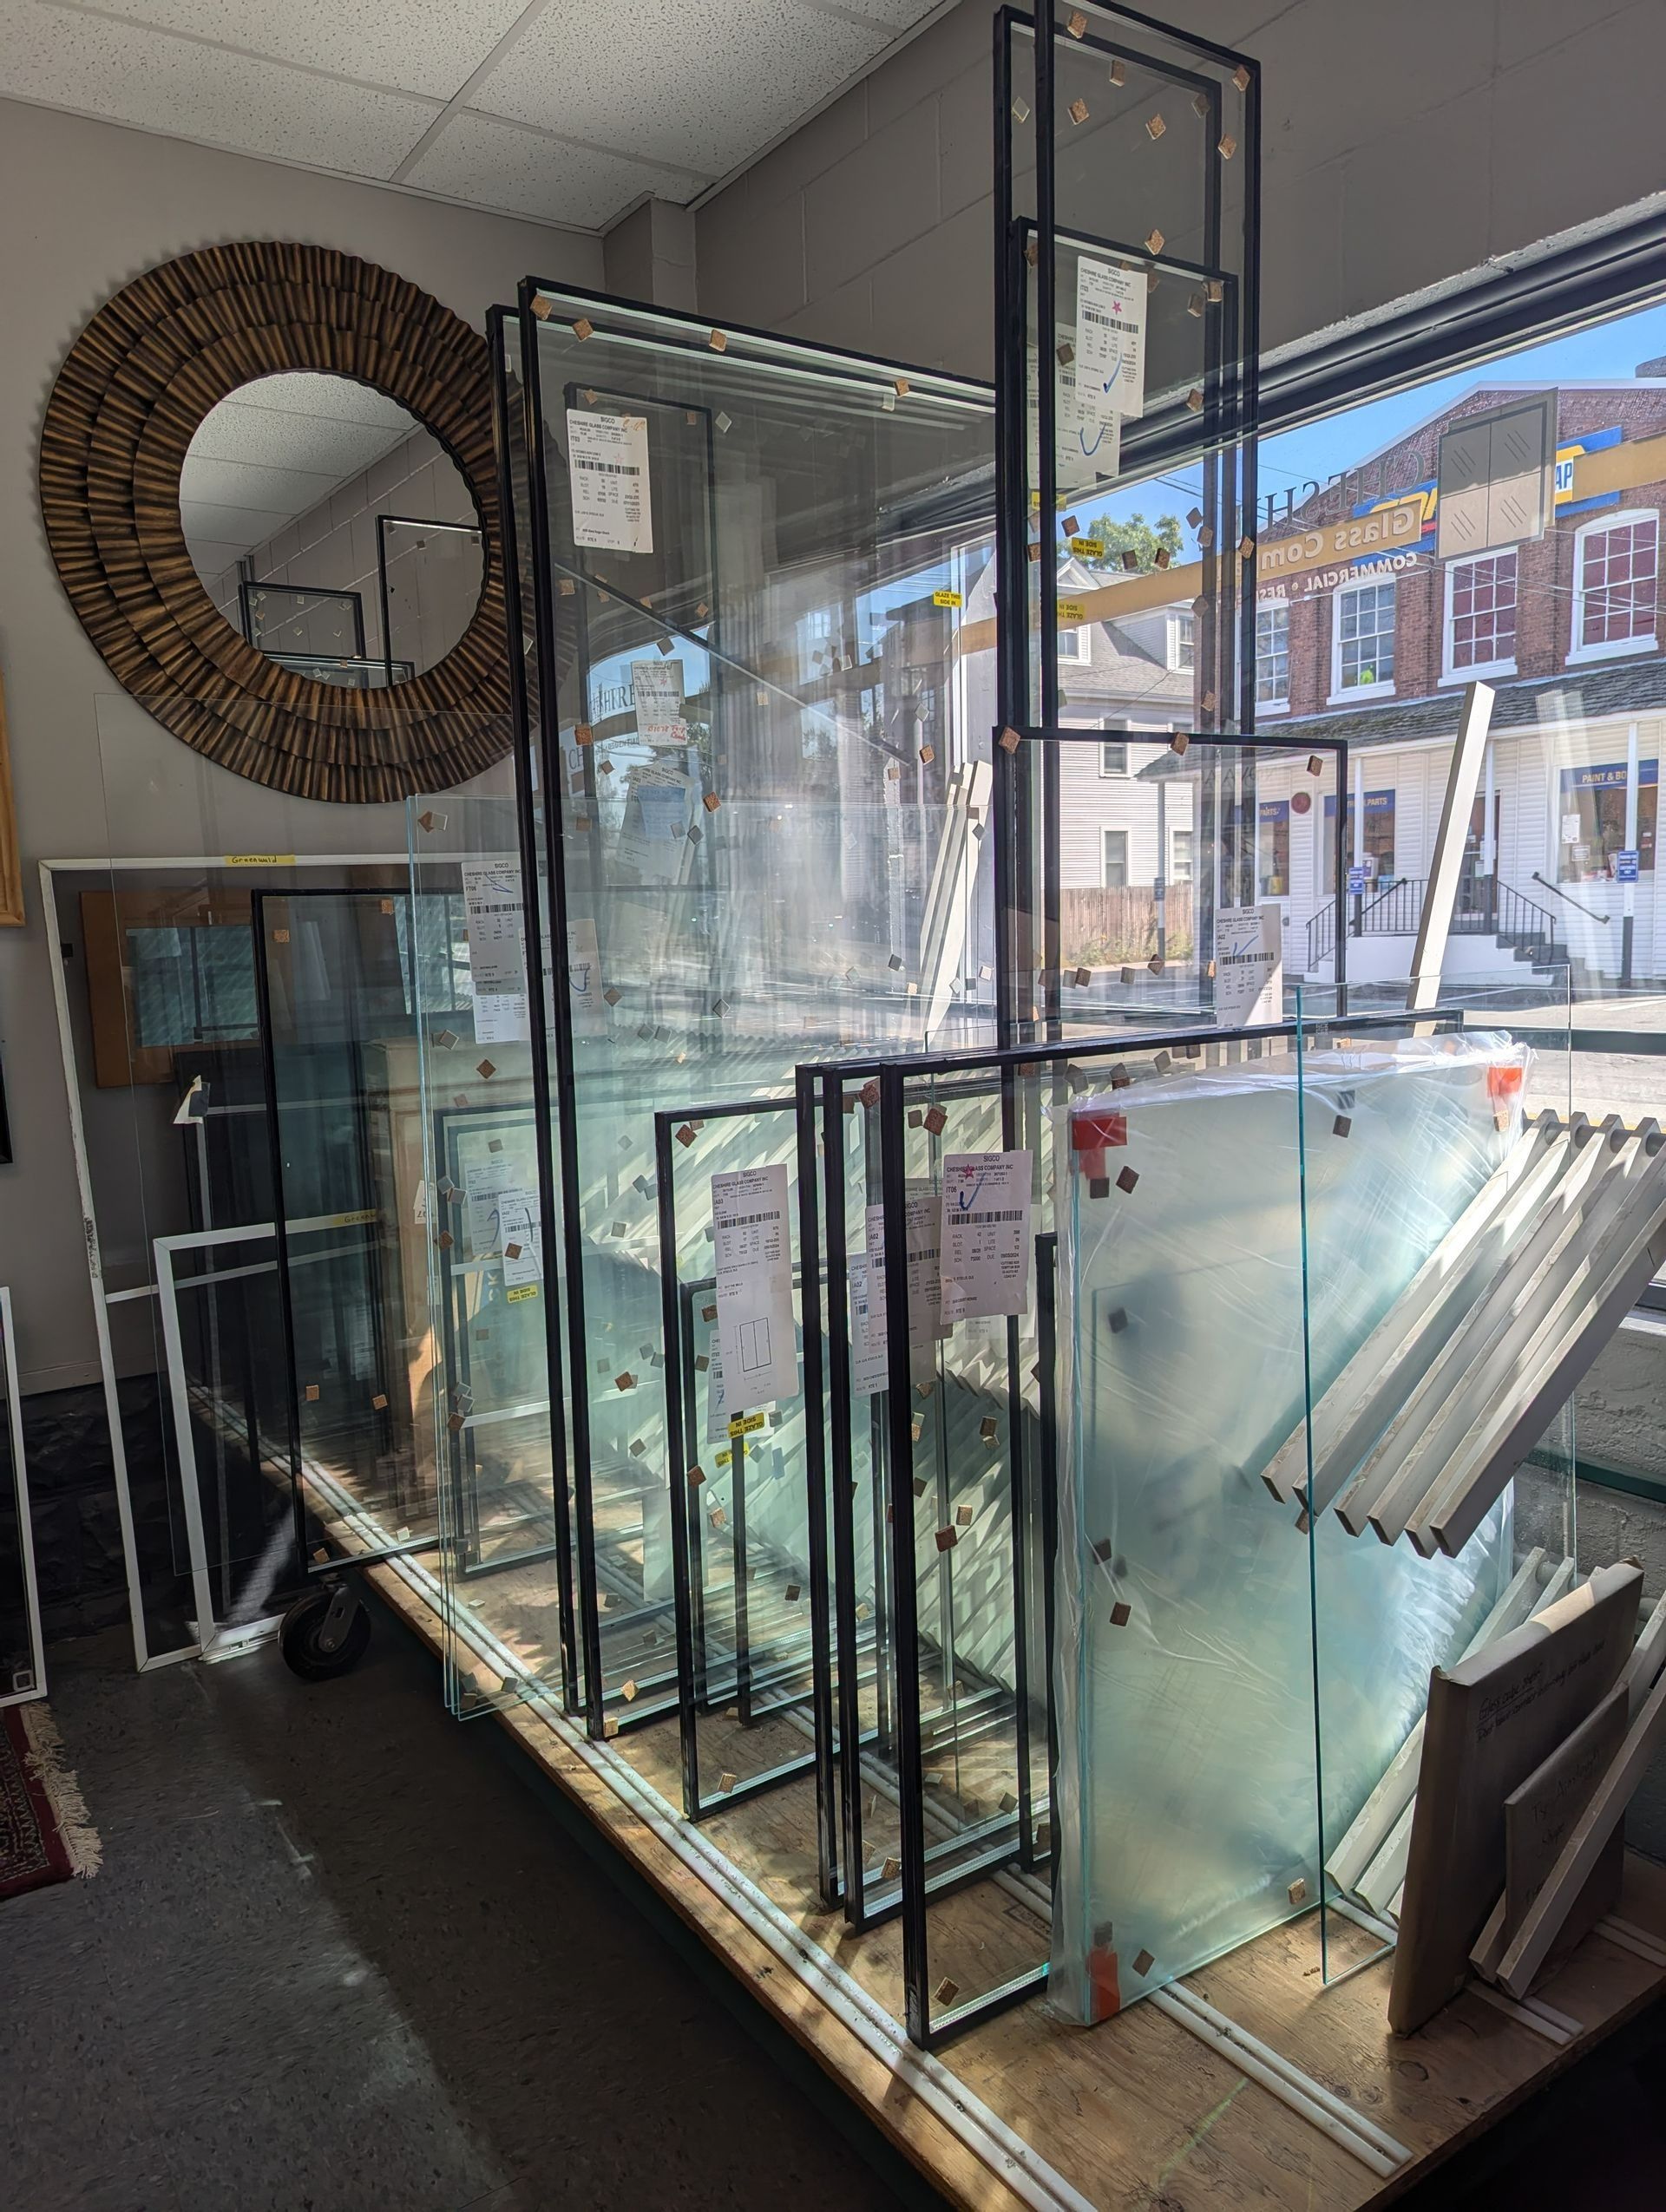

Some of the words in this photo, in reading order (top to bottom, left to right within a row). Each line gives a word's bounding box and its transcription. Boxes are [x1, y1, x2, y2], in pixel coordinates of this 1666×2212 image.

[1086, 549, 1103, 558] GLAZE
[1583, 774, 1605, 782] PAINT
[1367, 797, 1387, 806] PARTS
[743, 1416, 757, 1425] SIDE
[730, 1427, 743, 1437] THIS
[743, 1422, 764, 1434] GLAZE
